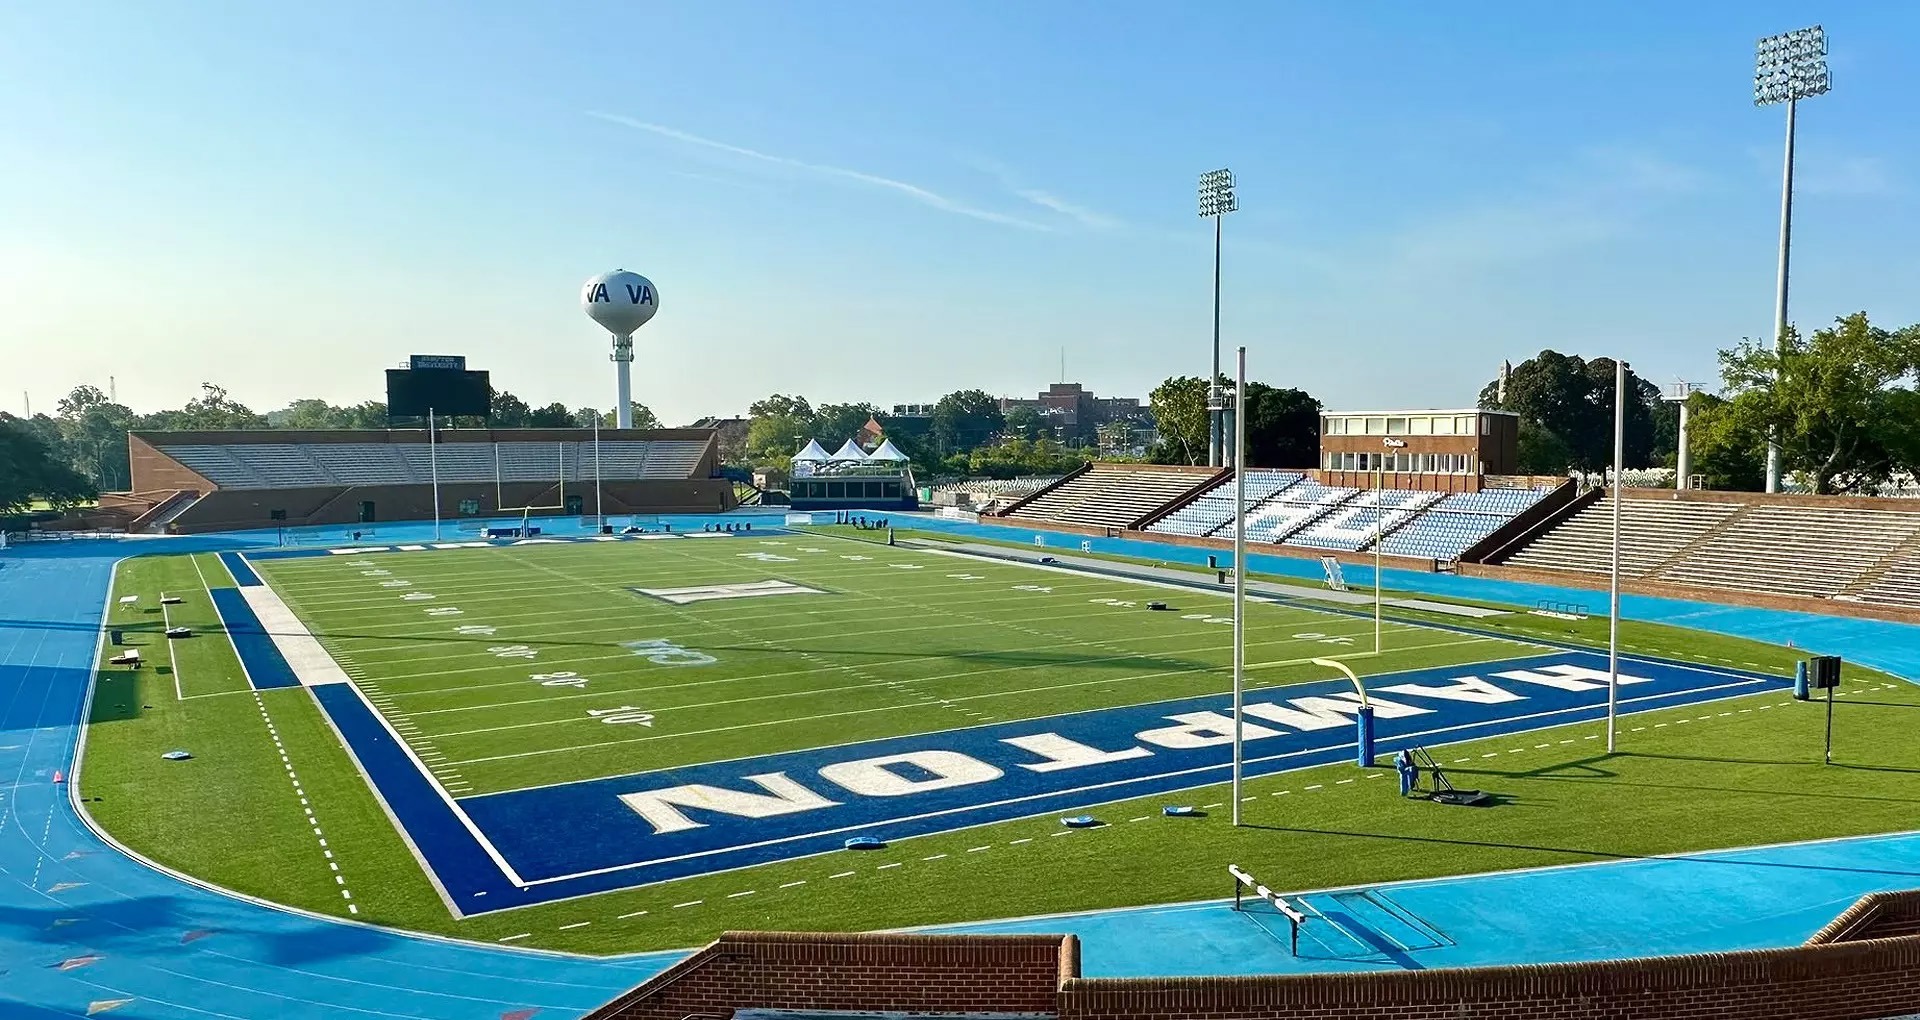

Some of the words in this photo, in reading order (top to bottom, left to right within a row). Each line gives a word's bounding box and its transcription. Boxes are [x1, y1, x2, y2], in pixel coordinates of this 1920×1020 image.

[625, 284, 653, 305] VA
[587, 706, 654, 727] 10
[617, 664, 1654, 835] HAMPTON
